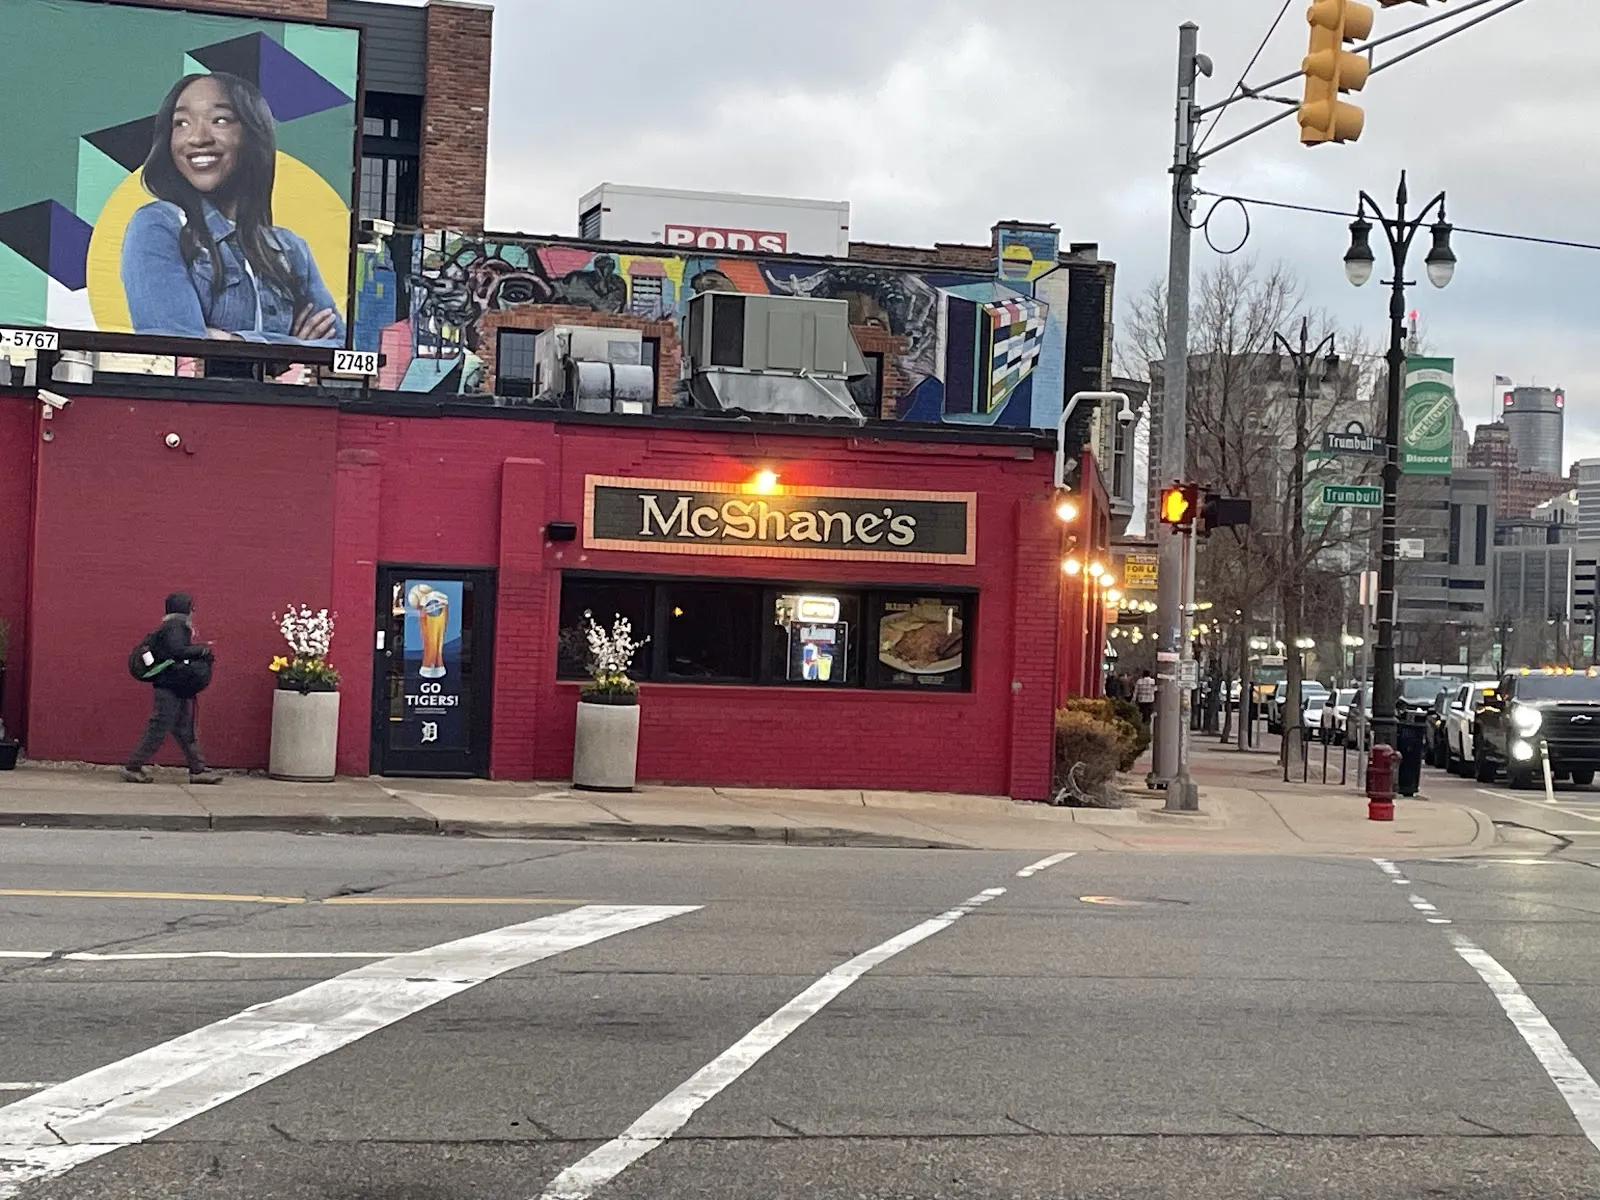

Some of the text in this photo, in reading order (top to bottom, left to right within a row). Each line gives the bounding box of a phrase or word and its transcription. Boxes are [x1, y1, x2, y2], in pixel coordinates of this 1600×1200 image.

[668, 228, 783, 253] PODS
[337, 353, 374, 372] 2748
[1407, 398, 1452, 444] Corktown
[1328, 434, 1374, 451] Trumbull
[1406, 454, 1450, 464] Discover
[1326, 488, 1380, 503] Trumbull
[638, 494, 917, 546] McShane's
[420, 682, 441, 694] GO
[404, 694, 459, 706] TIGERS!
